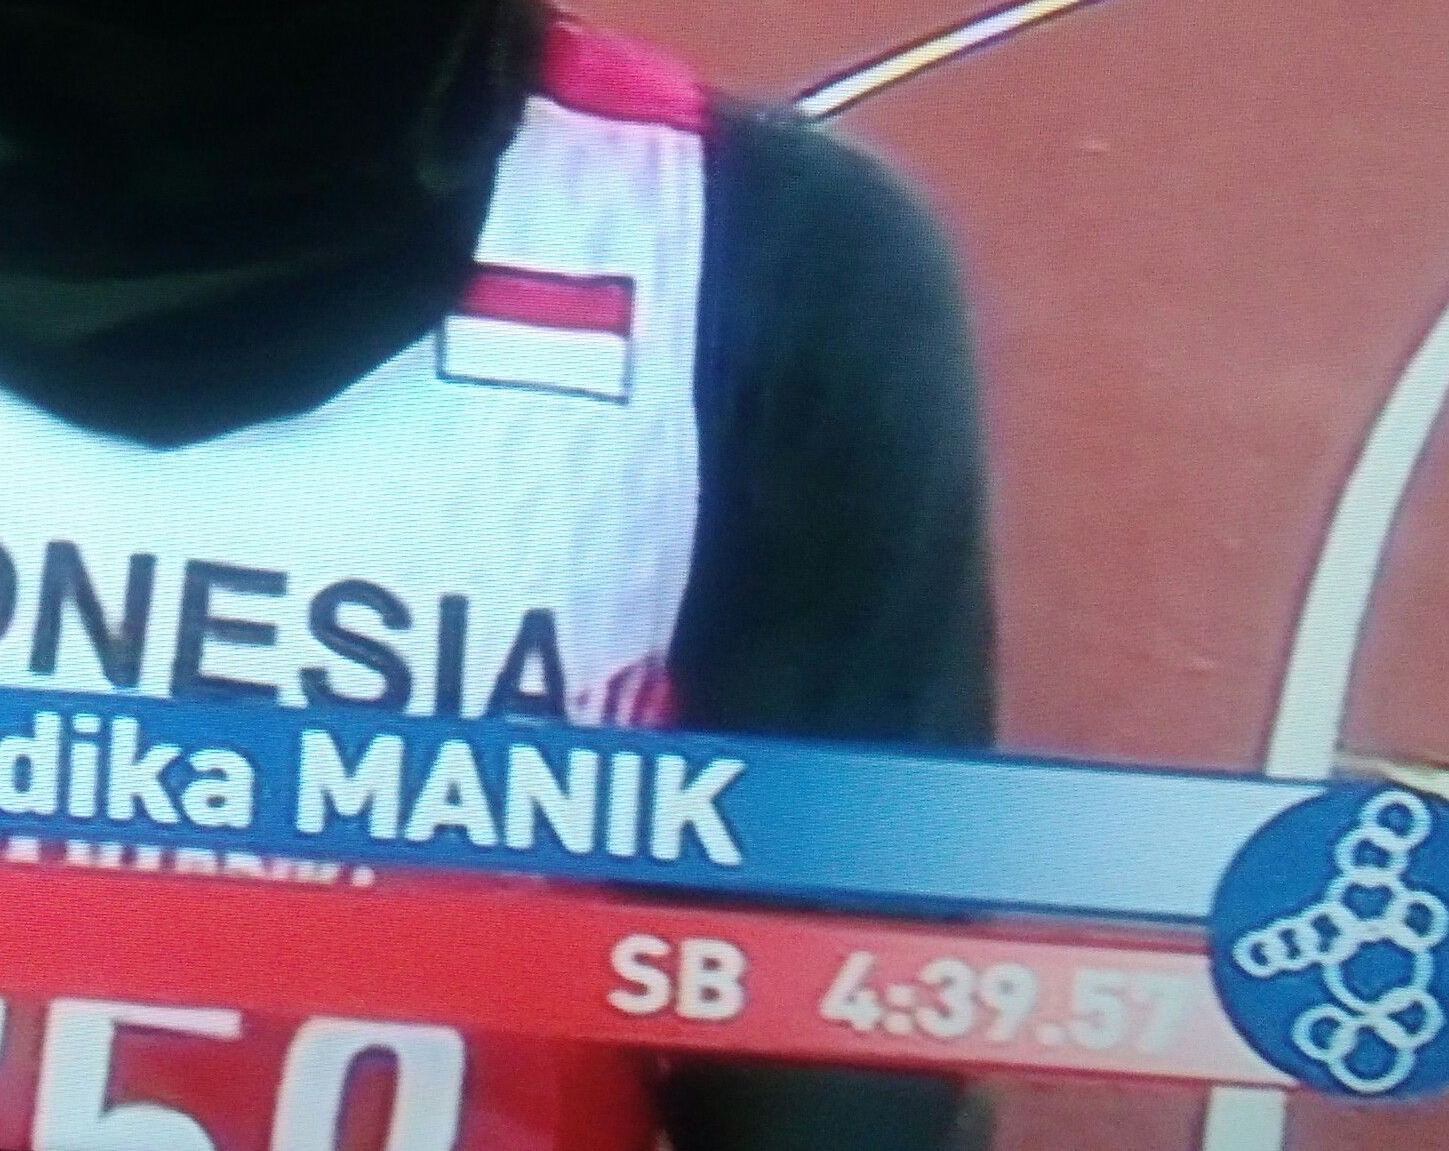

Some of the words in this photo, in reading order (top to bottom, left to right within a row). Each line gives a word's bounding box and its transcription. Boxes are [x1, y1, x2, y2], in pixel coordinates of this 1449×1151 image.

[295, 729, 746, 866] MANIK
[608, 933, 748, 1021] SB
[820, 951, 1190, 1051] 4:39.57
